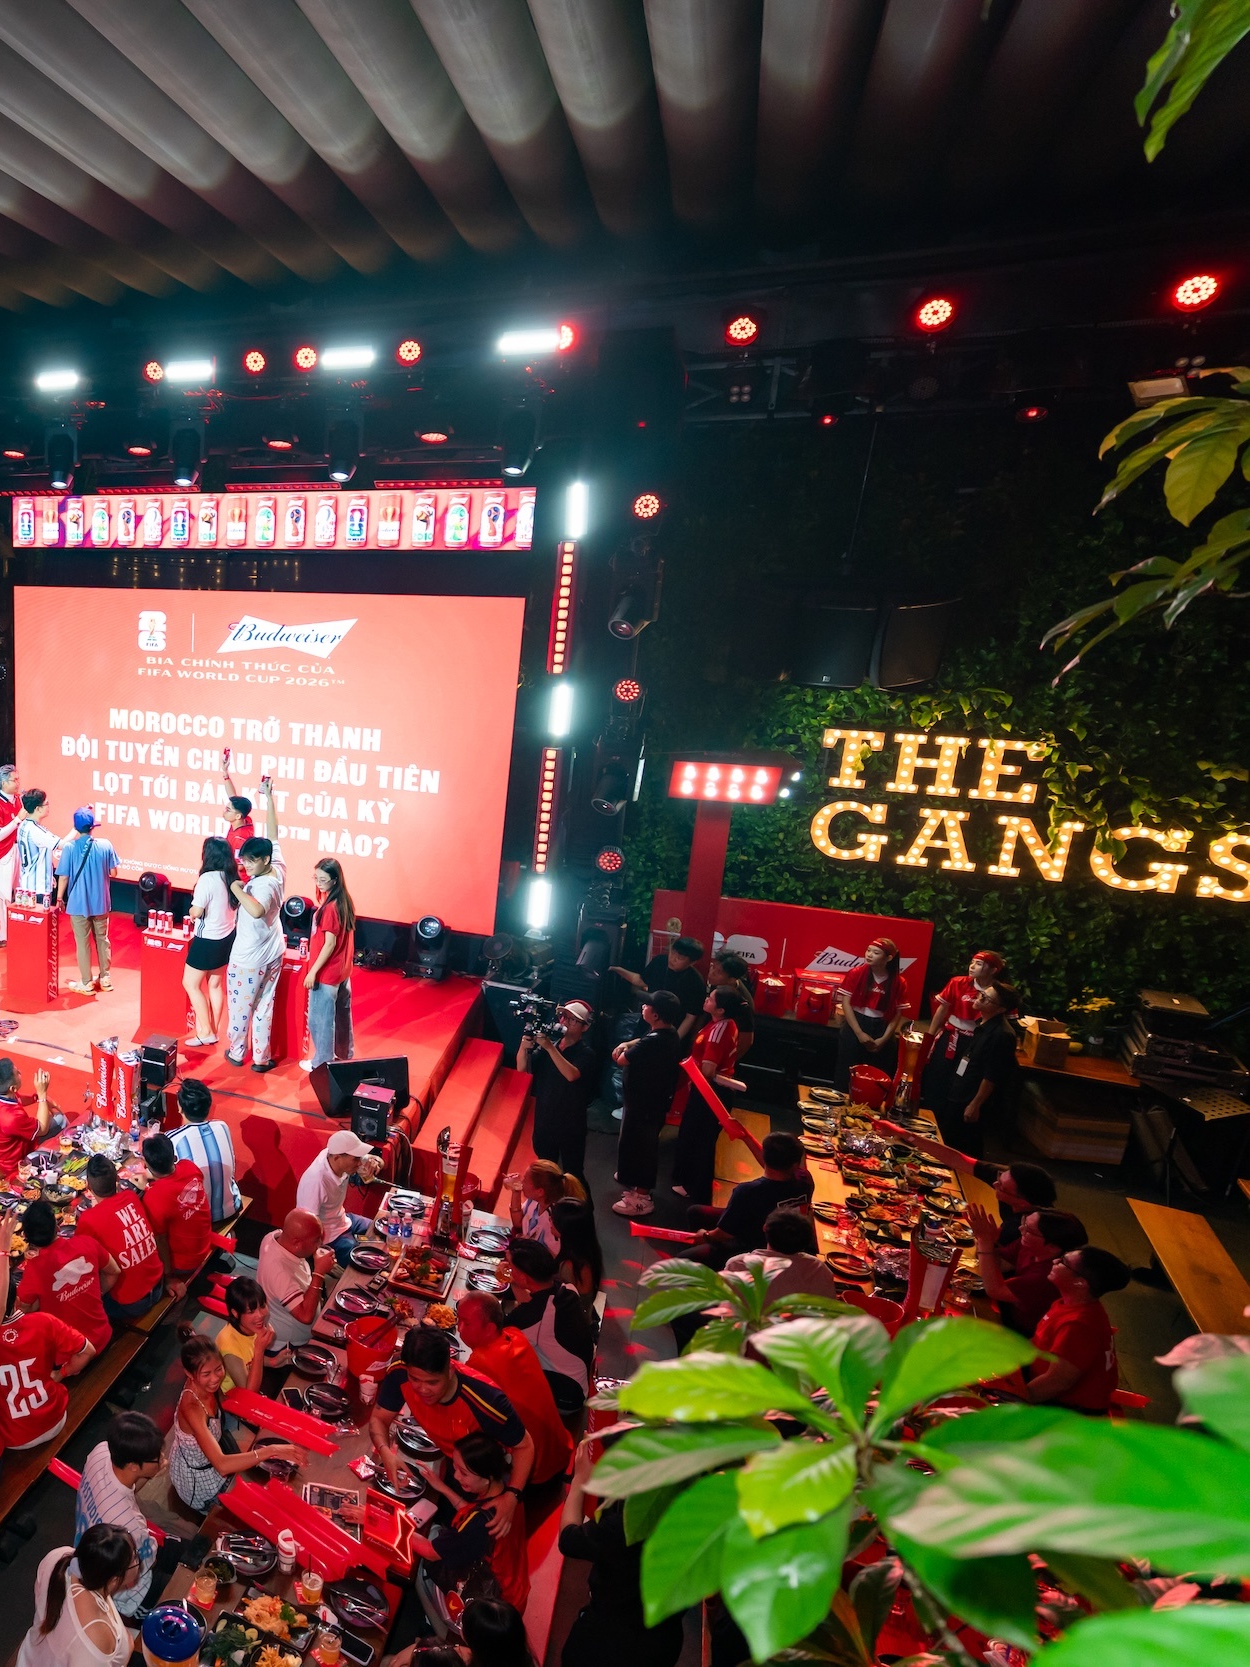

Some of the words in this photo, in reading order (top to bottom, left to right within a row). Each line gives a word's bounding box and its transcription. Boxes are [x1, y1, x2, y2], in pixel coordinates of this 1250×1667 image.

[228, 622, 343, 644] Budweiser
[137, 667, 172, 678] FIFA
[177, 670, 240, 682] WORLD
[245, 674, 281, 684] CUP
[146, 656, 174, 666] BIA
[181, 657, 235, 669] CHÍNH
[241, 660, 292, 673] THỨC
[298, 662, 335, 675] CỦA
[109, 708, 225, 738] MOROCCO
[231, 715, 281, 743] TRỞ
[288, 721, 382, 752] THÀNH
[61, 734, 99, 761] ĐỘI
[105, 738, 180, 767] TUYỂN
[261, 754, 305, 781] PHI
[313, 755, 368, 786] ĐẦU
[375, 763, 441, 794] TIÊN
[823, 729, 1047, 804] THE
[92, 770, 133, 796] LỌT
[139, 774, 177, 800] TỚI
[297, 790, 349, 820] CỦA
[357, 797, 396, 825] KỲ
[94, 802, 141, 827] FIFA
[148, 808, 232, 838] WORLD
[317, 828, 390, 859] NÀO?
[809, 801, 1250, 902] GANGS
[47, 911, 58, 1000] Budweiser
[96, 1057, 108, 1109] Budweiser
[115, 1066, 126, 1119] Budweiser
[115, 1203, 141, 1228] WE
[122, 1217, 151, 1249] ARE
[118, 1232, 157, 1270] SALES
